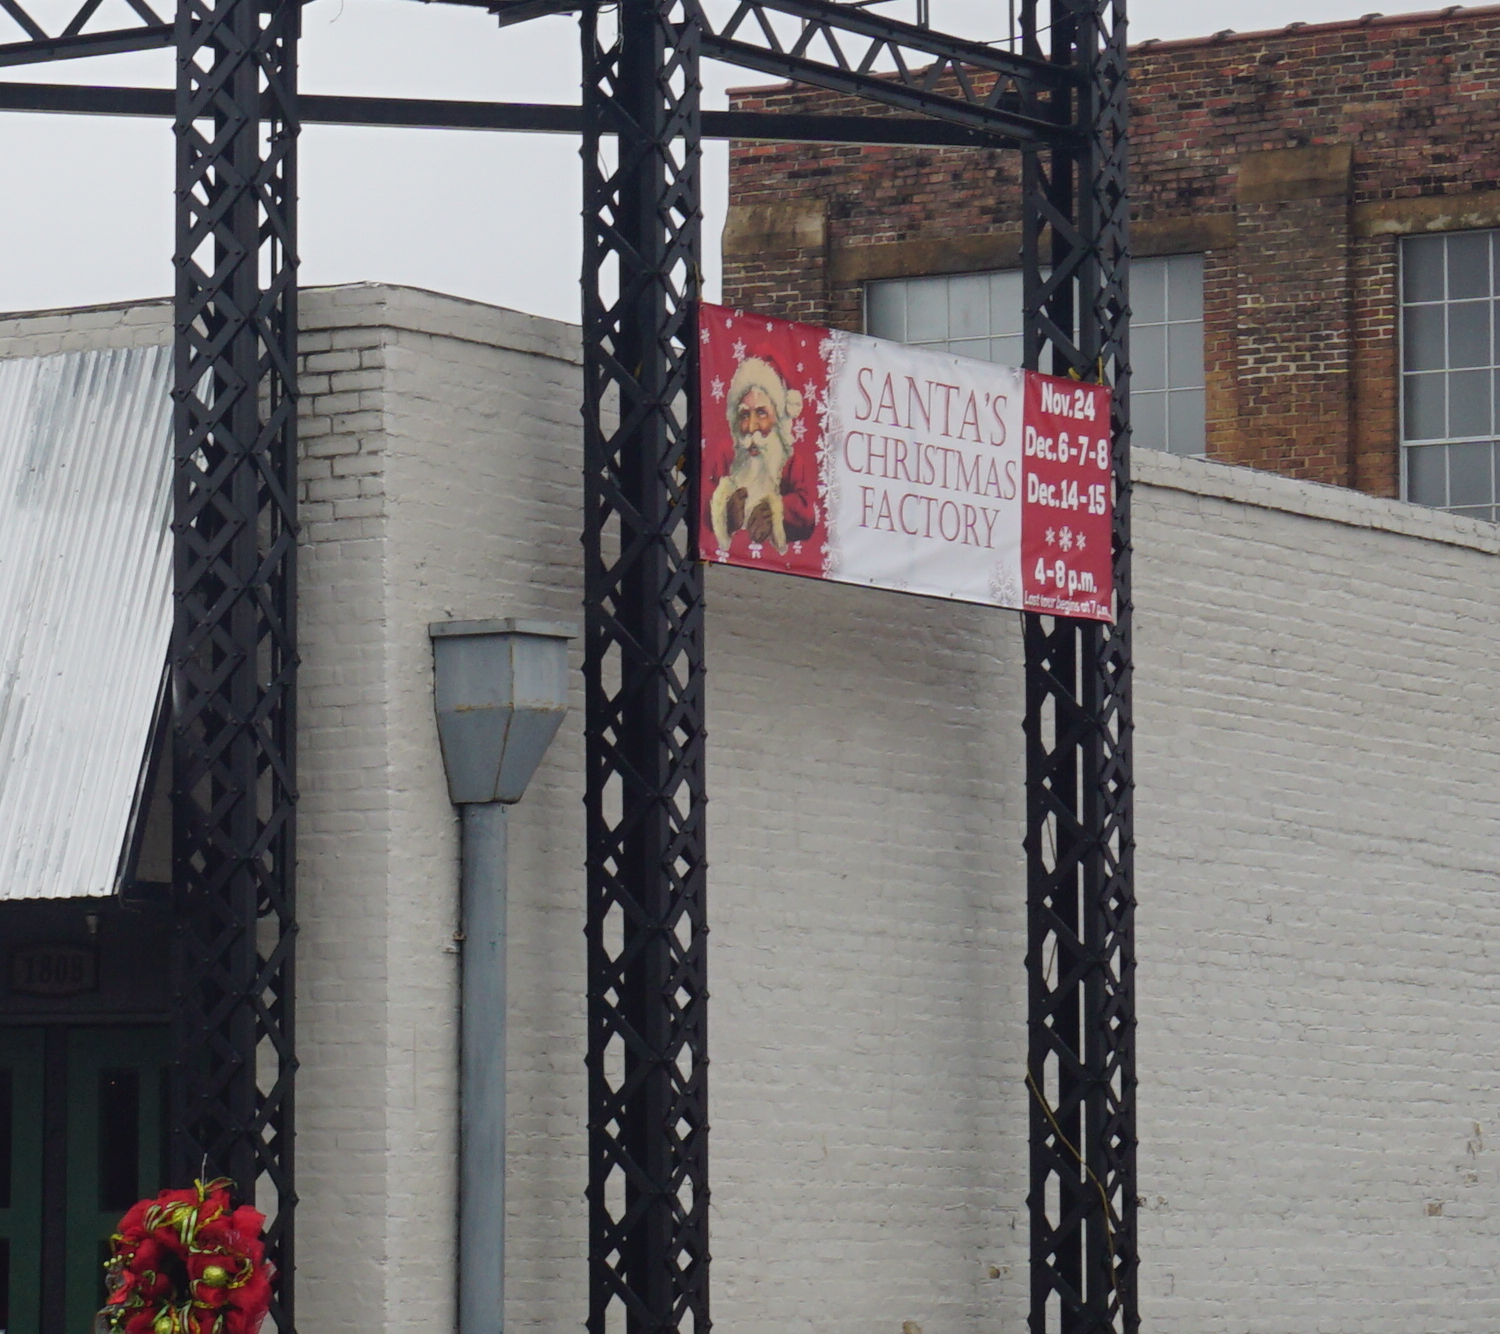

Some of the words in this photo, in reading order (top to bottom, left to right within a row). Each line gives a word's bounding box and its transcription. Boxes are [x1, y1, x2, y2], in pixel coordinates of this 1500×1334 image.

[854, 367, 1008, 447] SANTA'S
[842, 430, 1017, 501] CHRISTMAS
[858, 485, 1000, 549] FACTORY
[1034, 557, 1066, 589] 4-8
[1067, 569, 1098, 596] p.m.
[1090, 600, 1096, 613] 7
